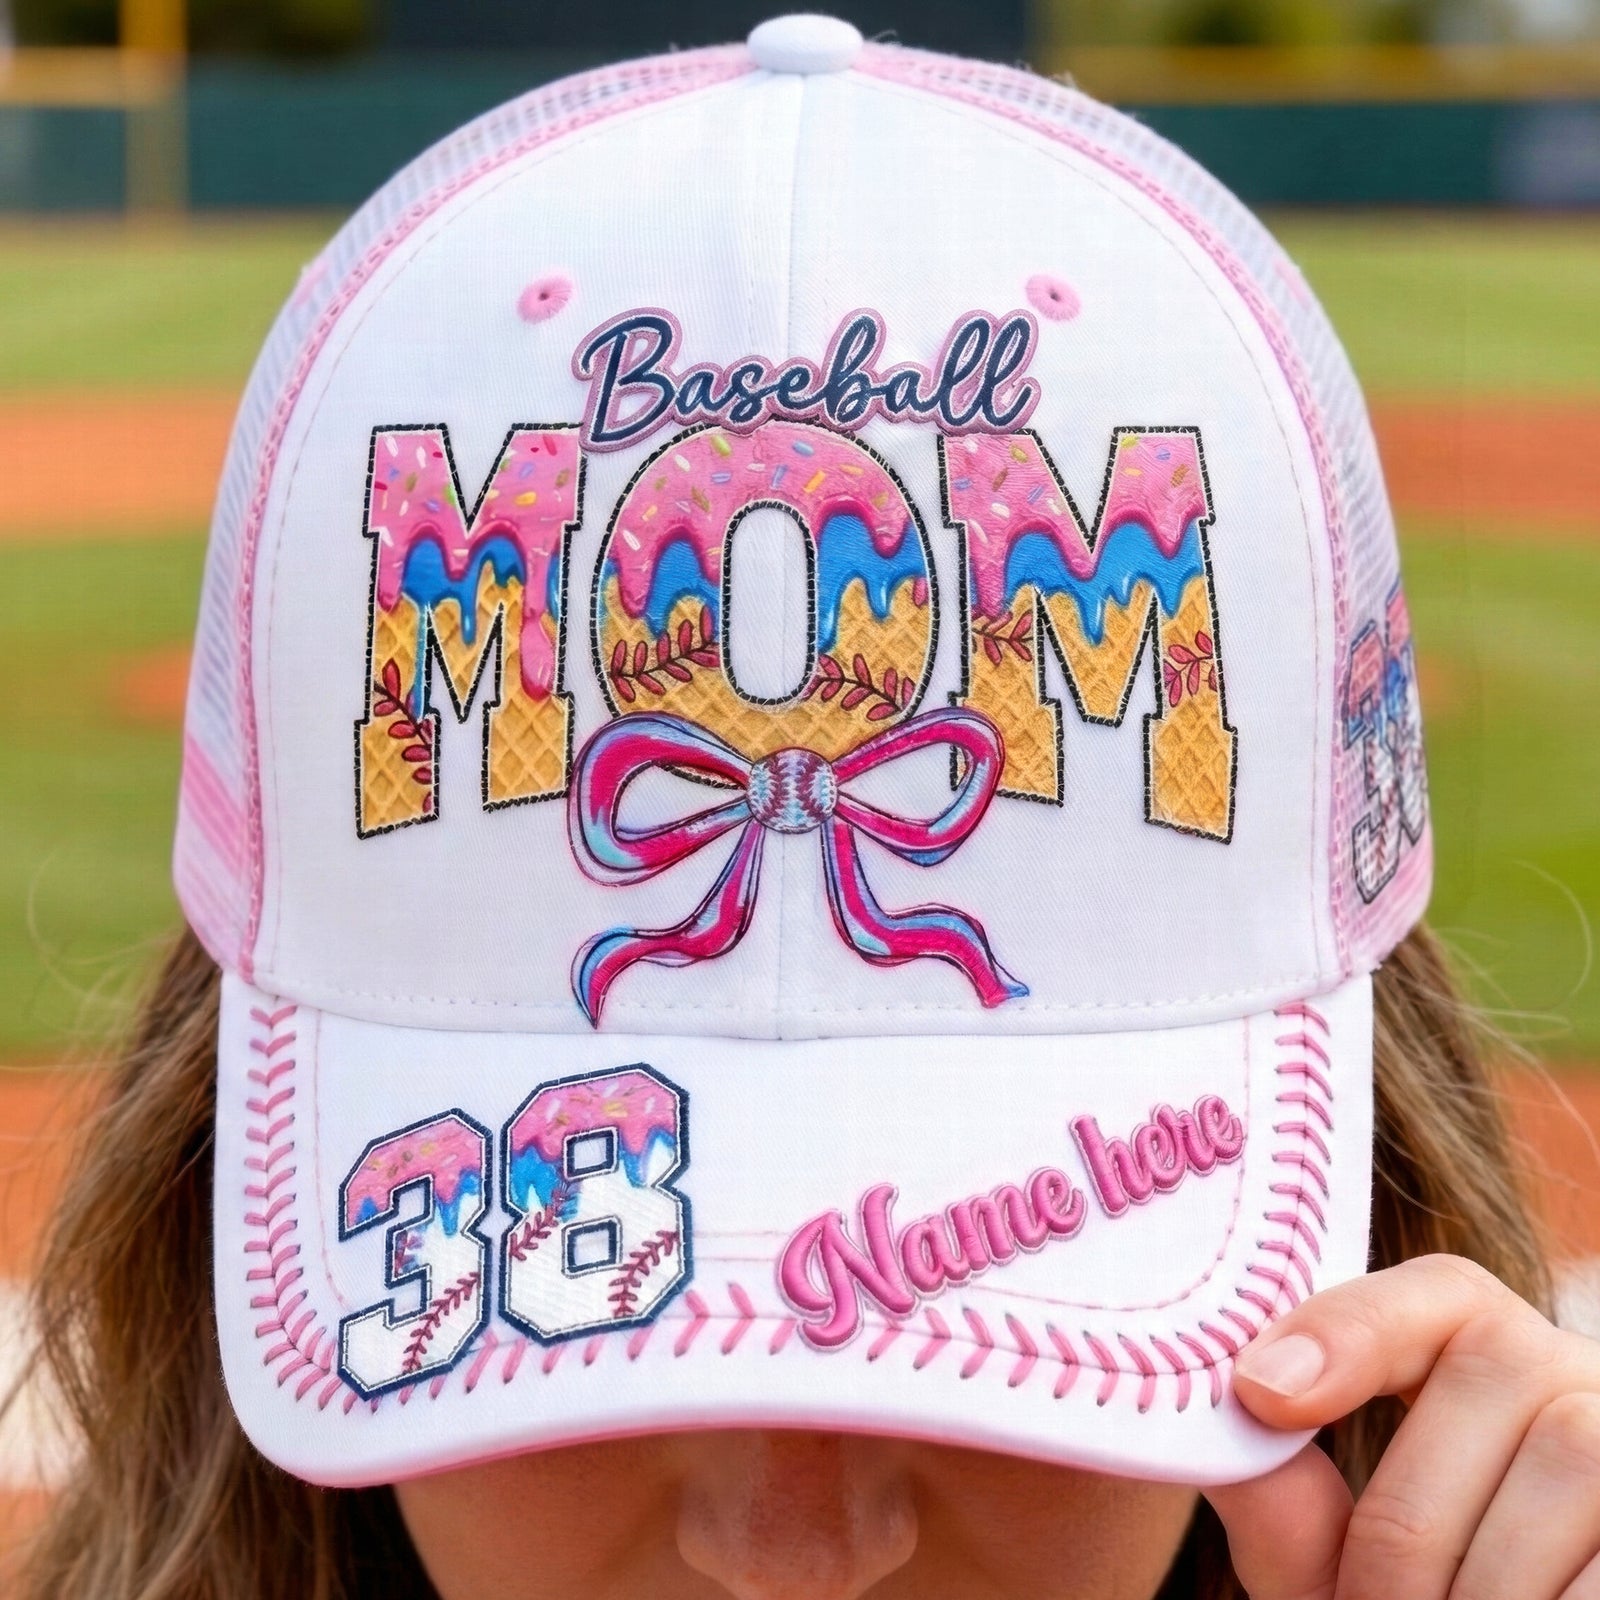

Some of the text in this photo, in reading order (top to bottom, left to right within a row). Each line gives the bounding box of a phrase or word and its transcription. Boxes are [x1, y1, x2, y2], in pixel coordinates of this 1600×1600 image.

[572, 308, 1041, 452] Baseball
[355, 422, 1237, 843] MOM
[337, 1062, 694, 1401] 38
[776, 1094, 1246, 1351] Name here
